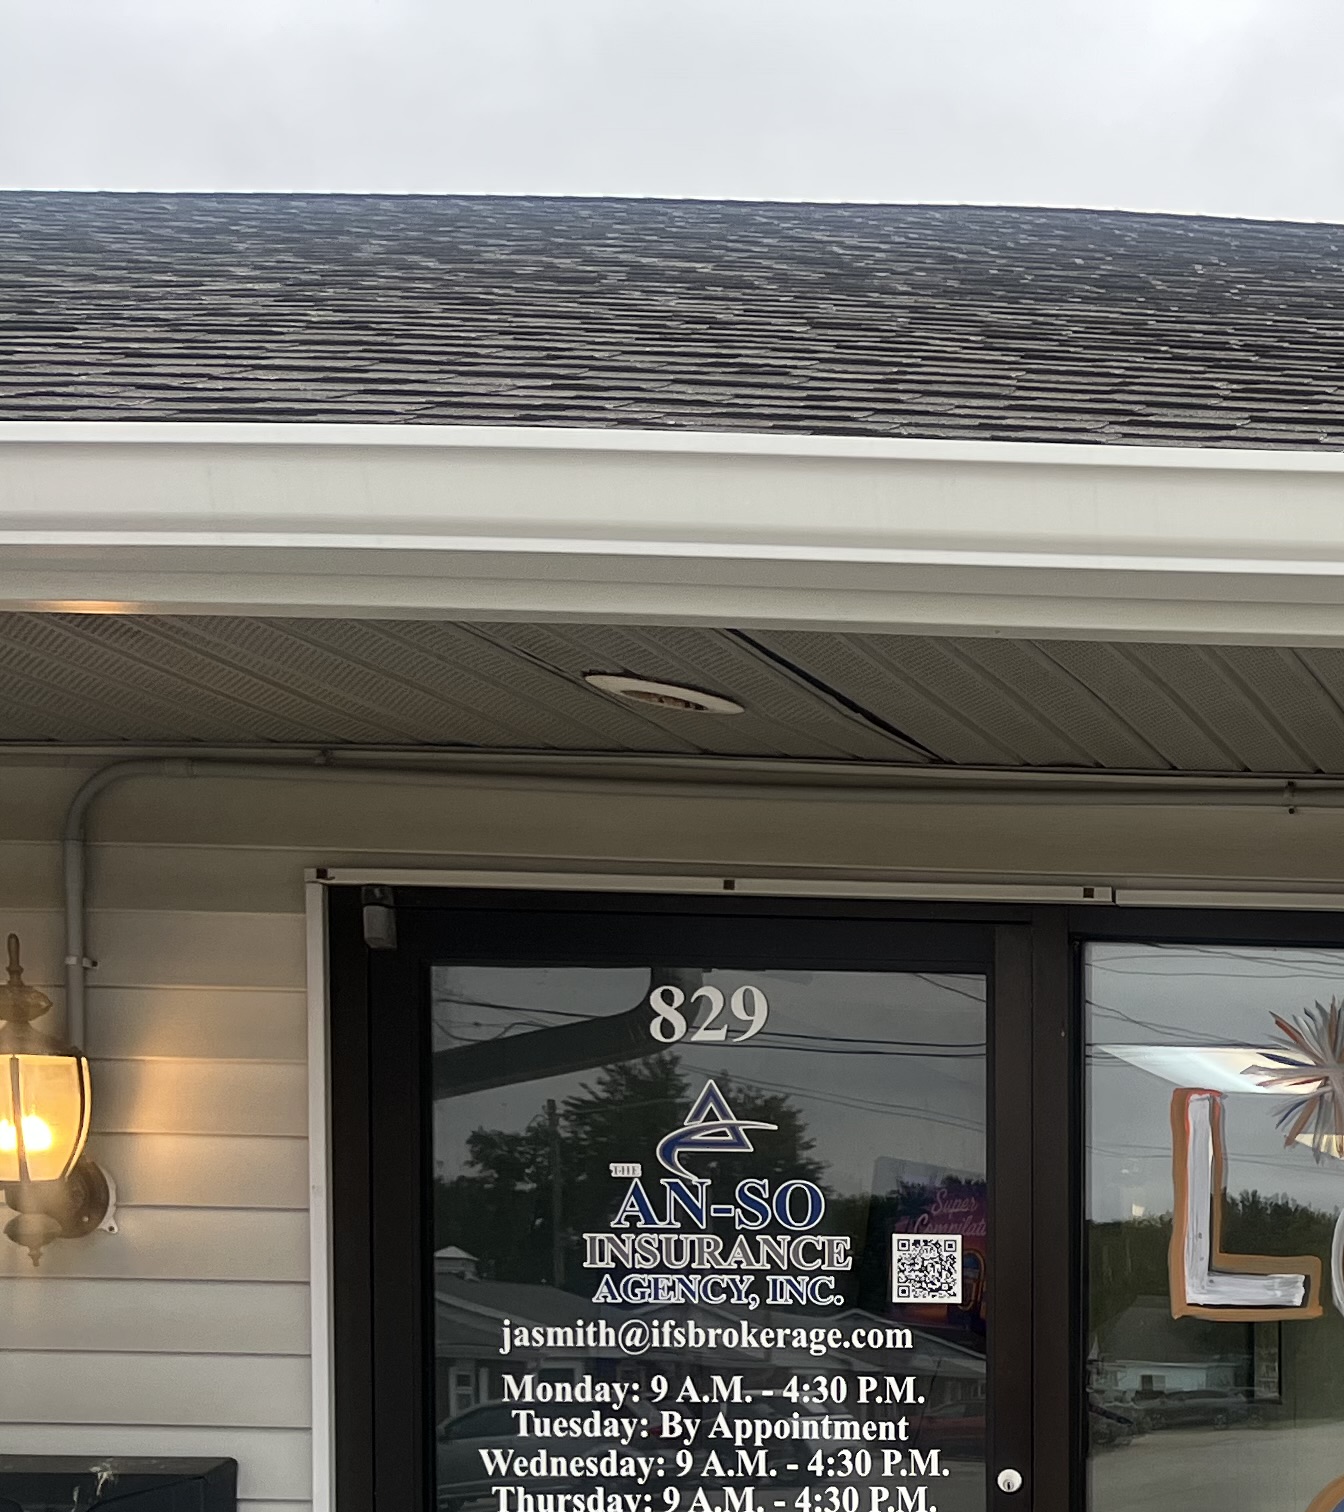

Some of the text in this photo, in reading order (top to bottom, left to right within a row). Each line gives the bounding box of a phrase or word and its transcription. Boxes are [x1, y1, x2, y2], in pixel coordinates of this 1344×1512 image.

[650, 985, 768, 1043] 829
[611, 1164, 640, 1176] THE
[610, 1178, 825, 1231] AN-SO
[931, 1188, 977, 1216] Super
[583, 1233, 852, 1270] INSURANCE
[592, 1274, 844, 1310] AGENCY, INC.
[499, 1318, 914, 1356] jasmith@ifsbrokerage.com
[502, 1375, 640, 1409] Monday:
[651, 1375, 667, 1403] 9
[676, 1375, 752, 1403] A.M.
[783, 1376, 847, 1403] 4:30
[857, 1376, 925, 1403] P.M.
[511, 1408, 910, 1447] Tuesday: By Appointment
[479, 1449, 665, 1484] Wednesday:
[676, 1449, 692, 1477] 9
[701, 1449, 777, 1477] A.M.
[808, 1449, 872, 1477] 4:30
[881, 1449, 950, 1477] P.M.
